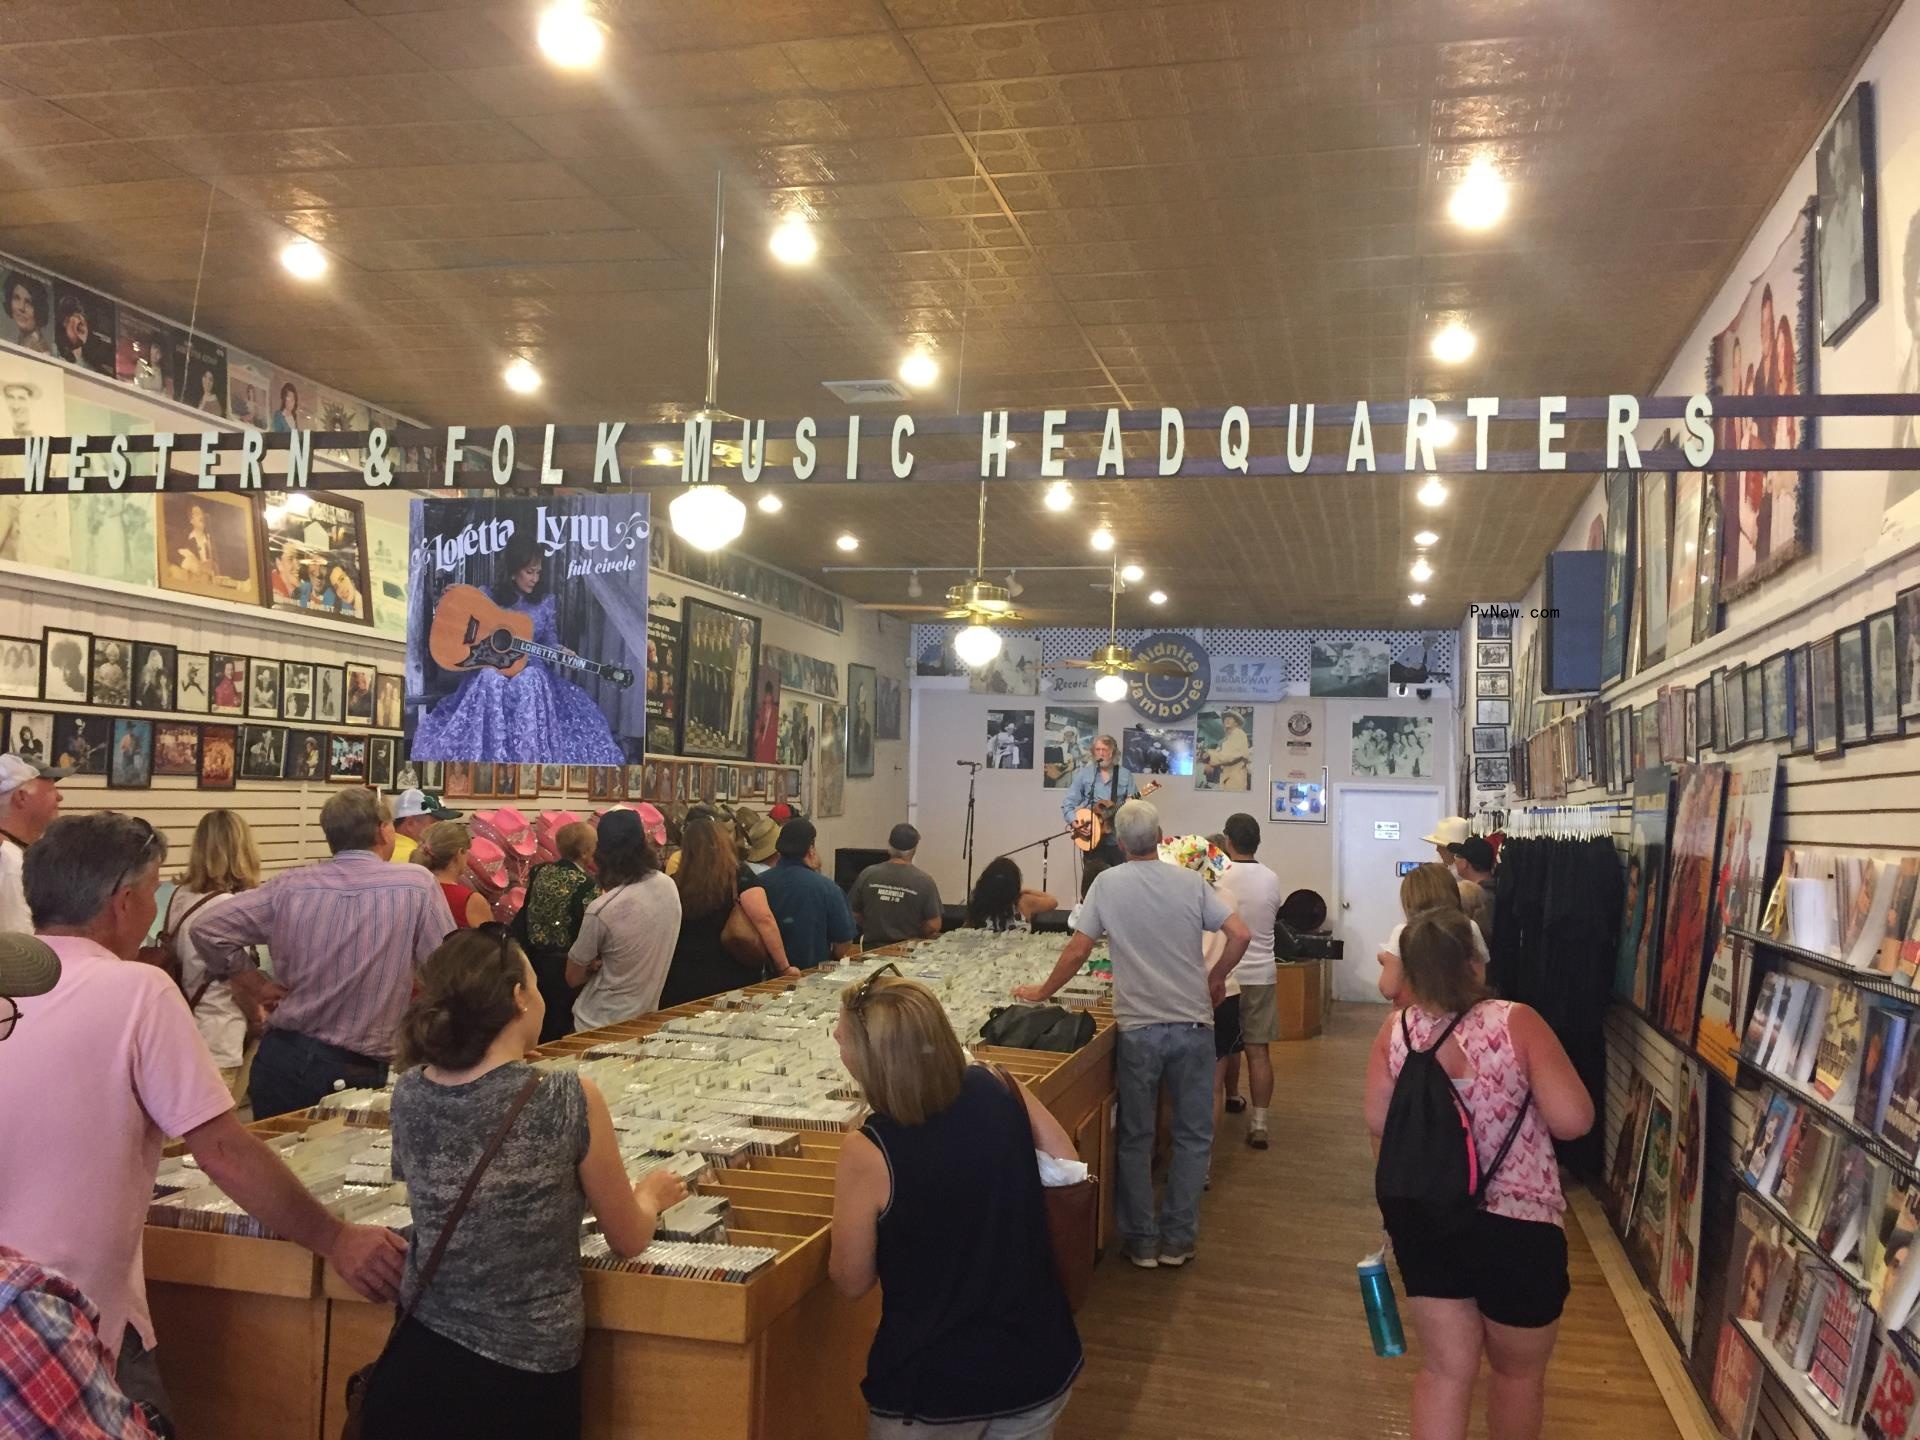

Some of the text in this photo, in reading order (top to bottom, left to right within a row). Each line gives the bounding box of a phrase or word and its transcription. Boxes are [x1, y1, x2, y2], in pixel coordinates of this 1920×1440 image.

[24, 394, 1715, 491] WESTERN & FOLK MUSIC HEADQUARTERS
[434, 506, 615, 572] Loretta Lynn
[567, 556, 636, 579] full circle
[520, 642, 586, 669] LORETTA LYNN
[1219, 662, 1266, 676] 417
[1054, 677, 1088, 691] Record
[1130, 680, 1204, 717] Jamboree
